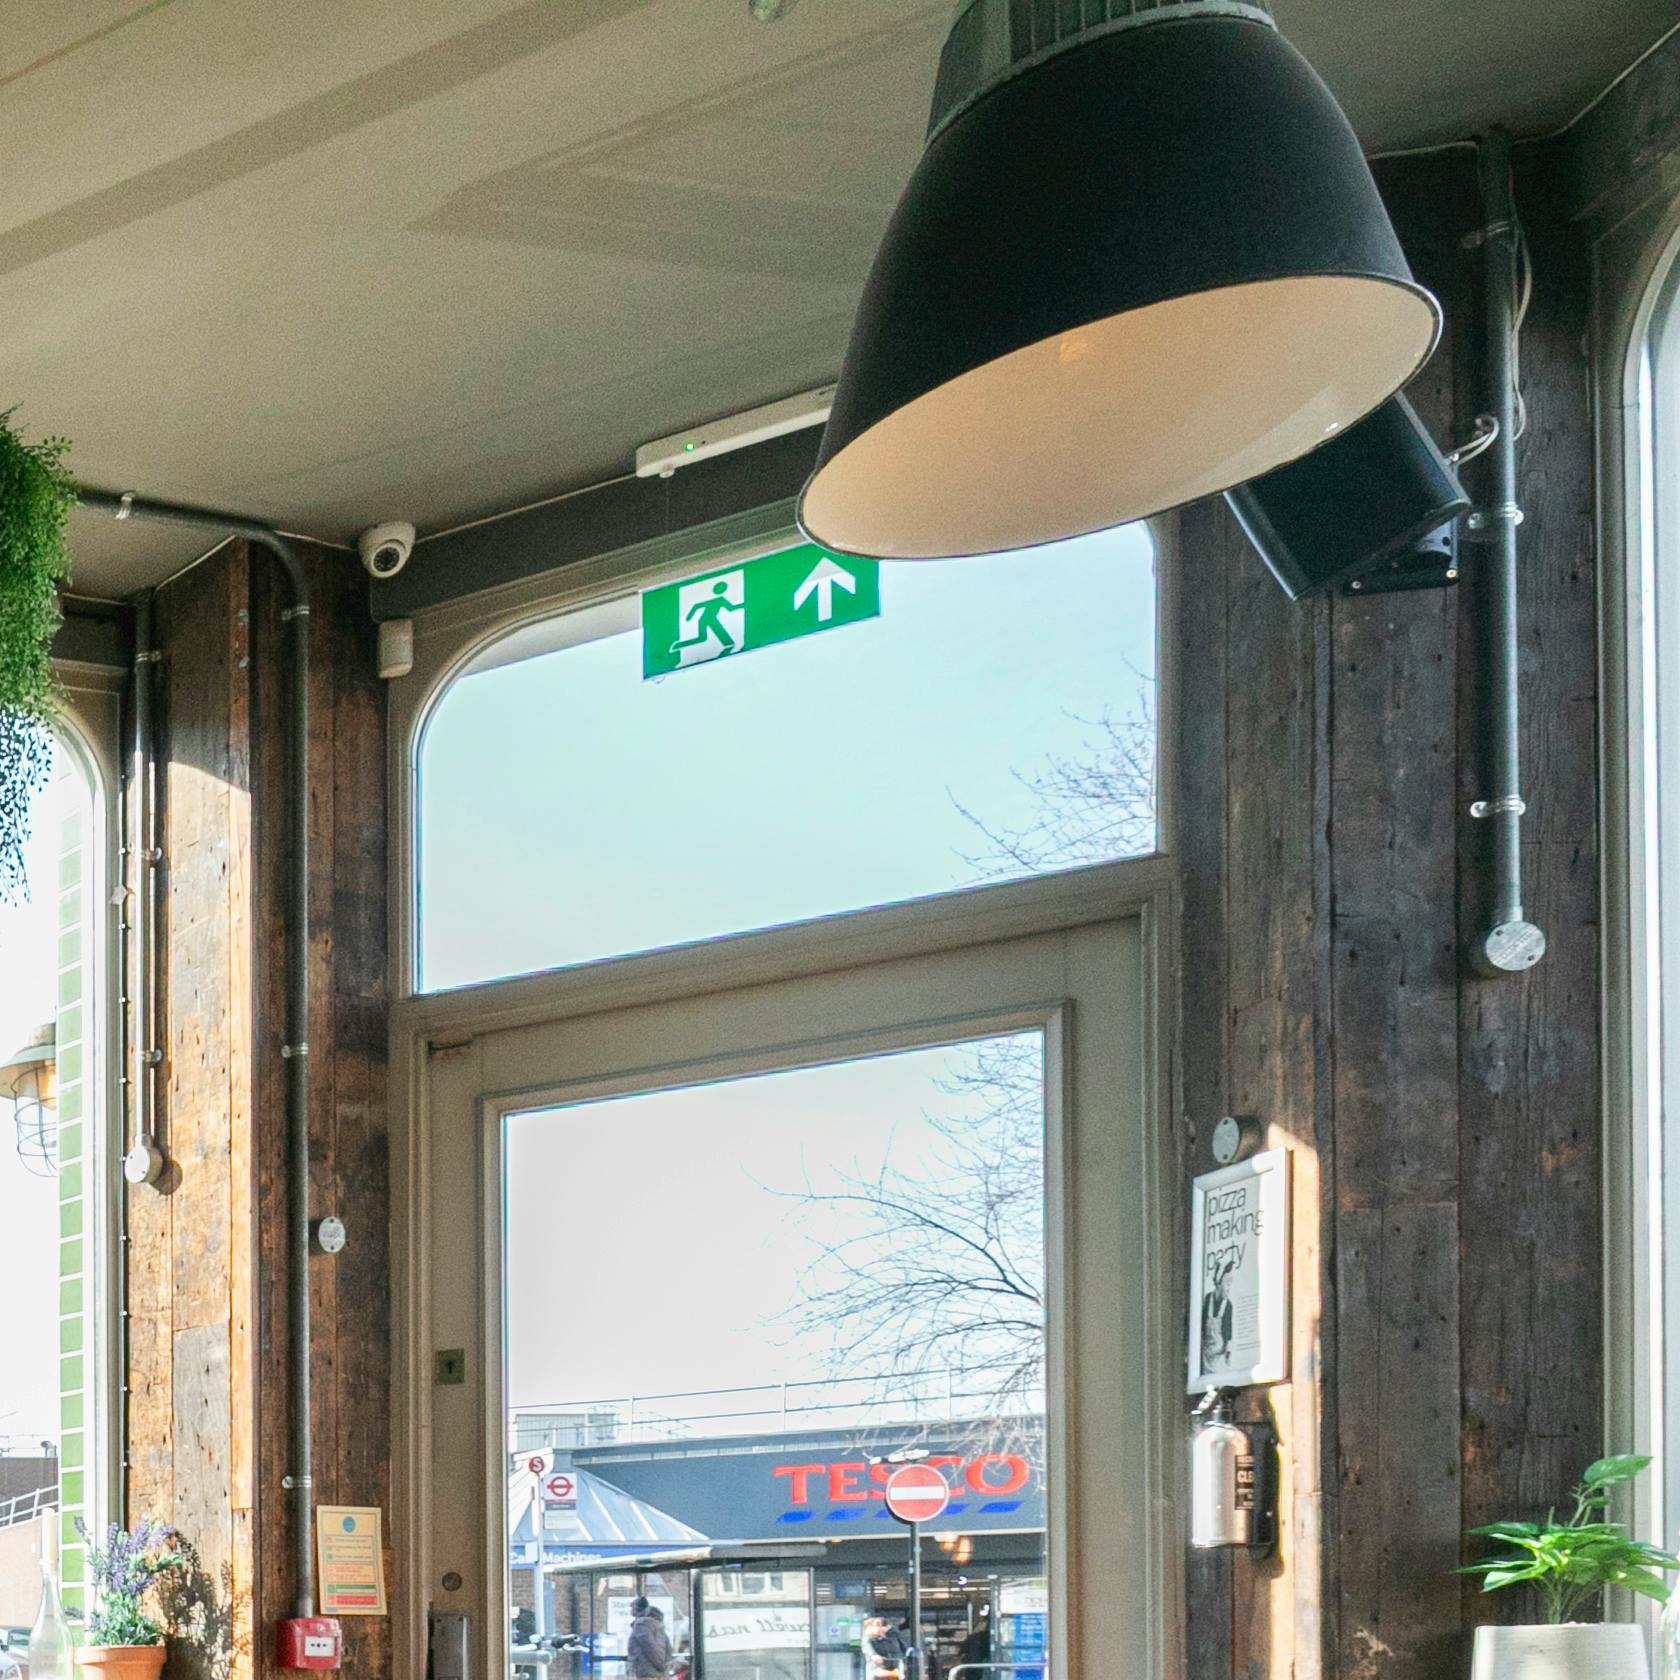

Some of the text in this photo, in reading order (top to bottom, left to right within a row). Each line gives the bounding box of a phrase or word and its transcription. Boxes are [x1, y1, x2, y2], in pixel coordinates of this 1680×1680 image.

[1207, 1186, 1247, 1223] pizza
[1206, 1207, 1265, 1245] making
[1205, 1241, 1247, 1277] party
